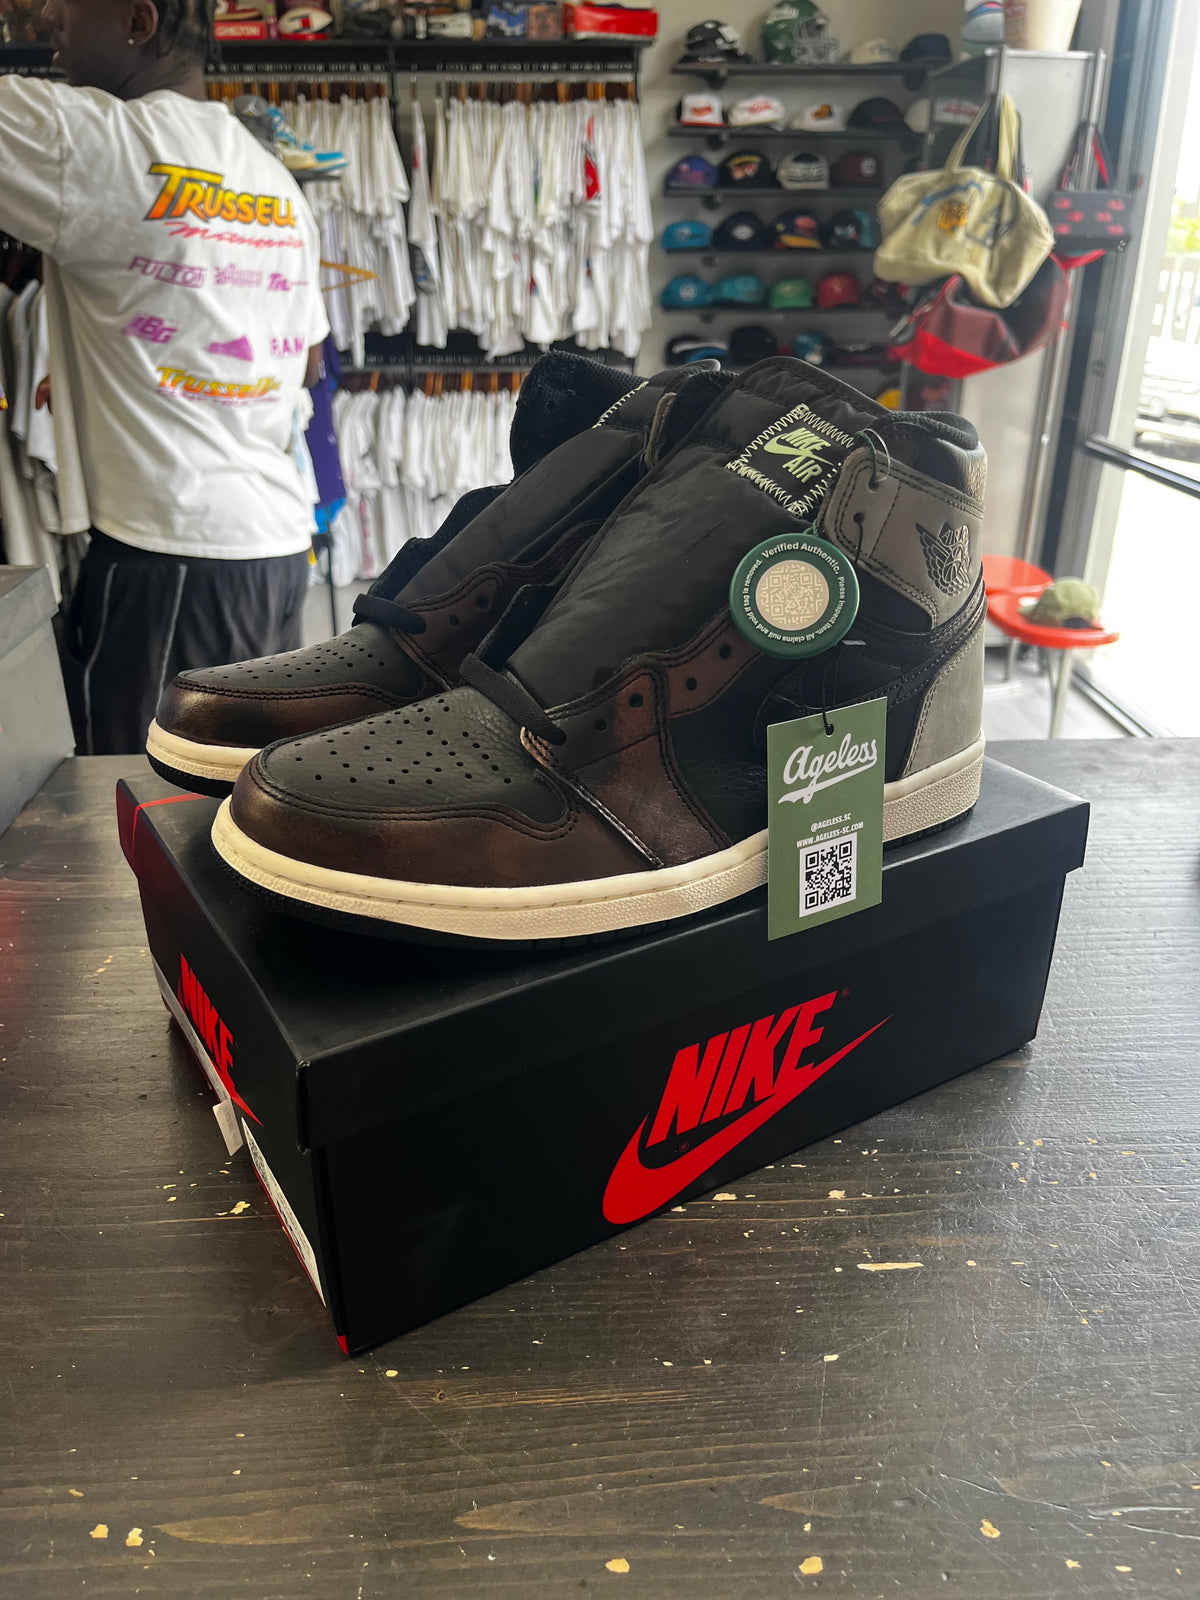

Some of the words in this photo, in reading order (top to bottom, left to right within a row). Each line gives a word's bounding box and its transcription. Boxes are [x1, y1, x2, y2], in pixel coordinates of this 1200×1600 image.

[780, 427, 832, 452] NIKE
[782, 456, 823, 483] AIR
[761, 542, 799, 559] Verified
[800, 543, 840, 575] Authentic.
[755, 623, 769, 635] and
[778, 732, 878, 805] Ageless
[796, 821, 864, 848] WWW.AGELESS-SC.COM
[811, 812, 852, 833] @AGELESS.SC
[180, 953, 235, 1088] NIKE
[646, 990, 838, 1149] NIKE
